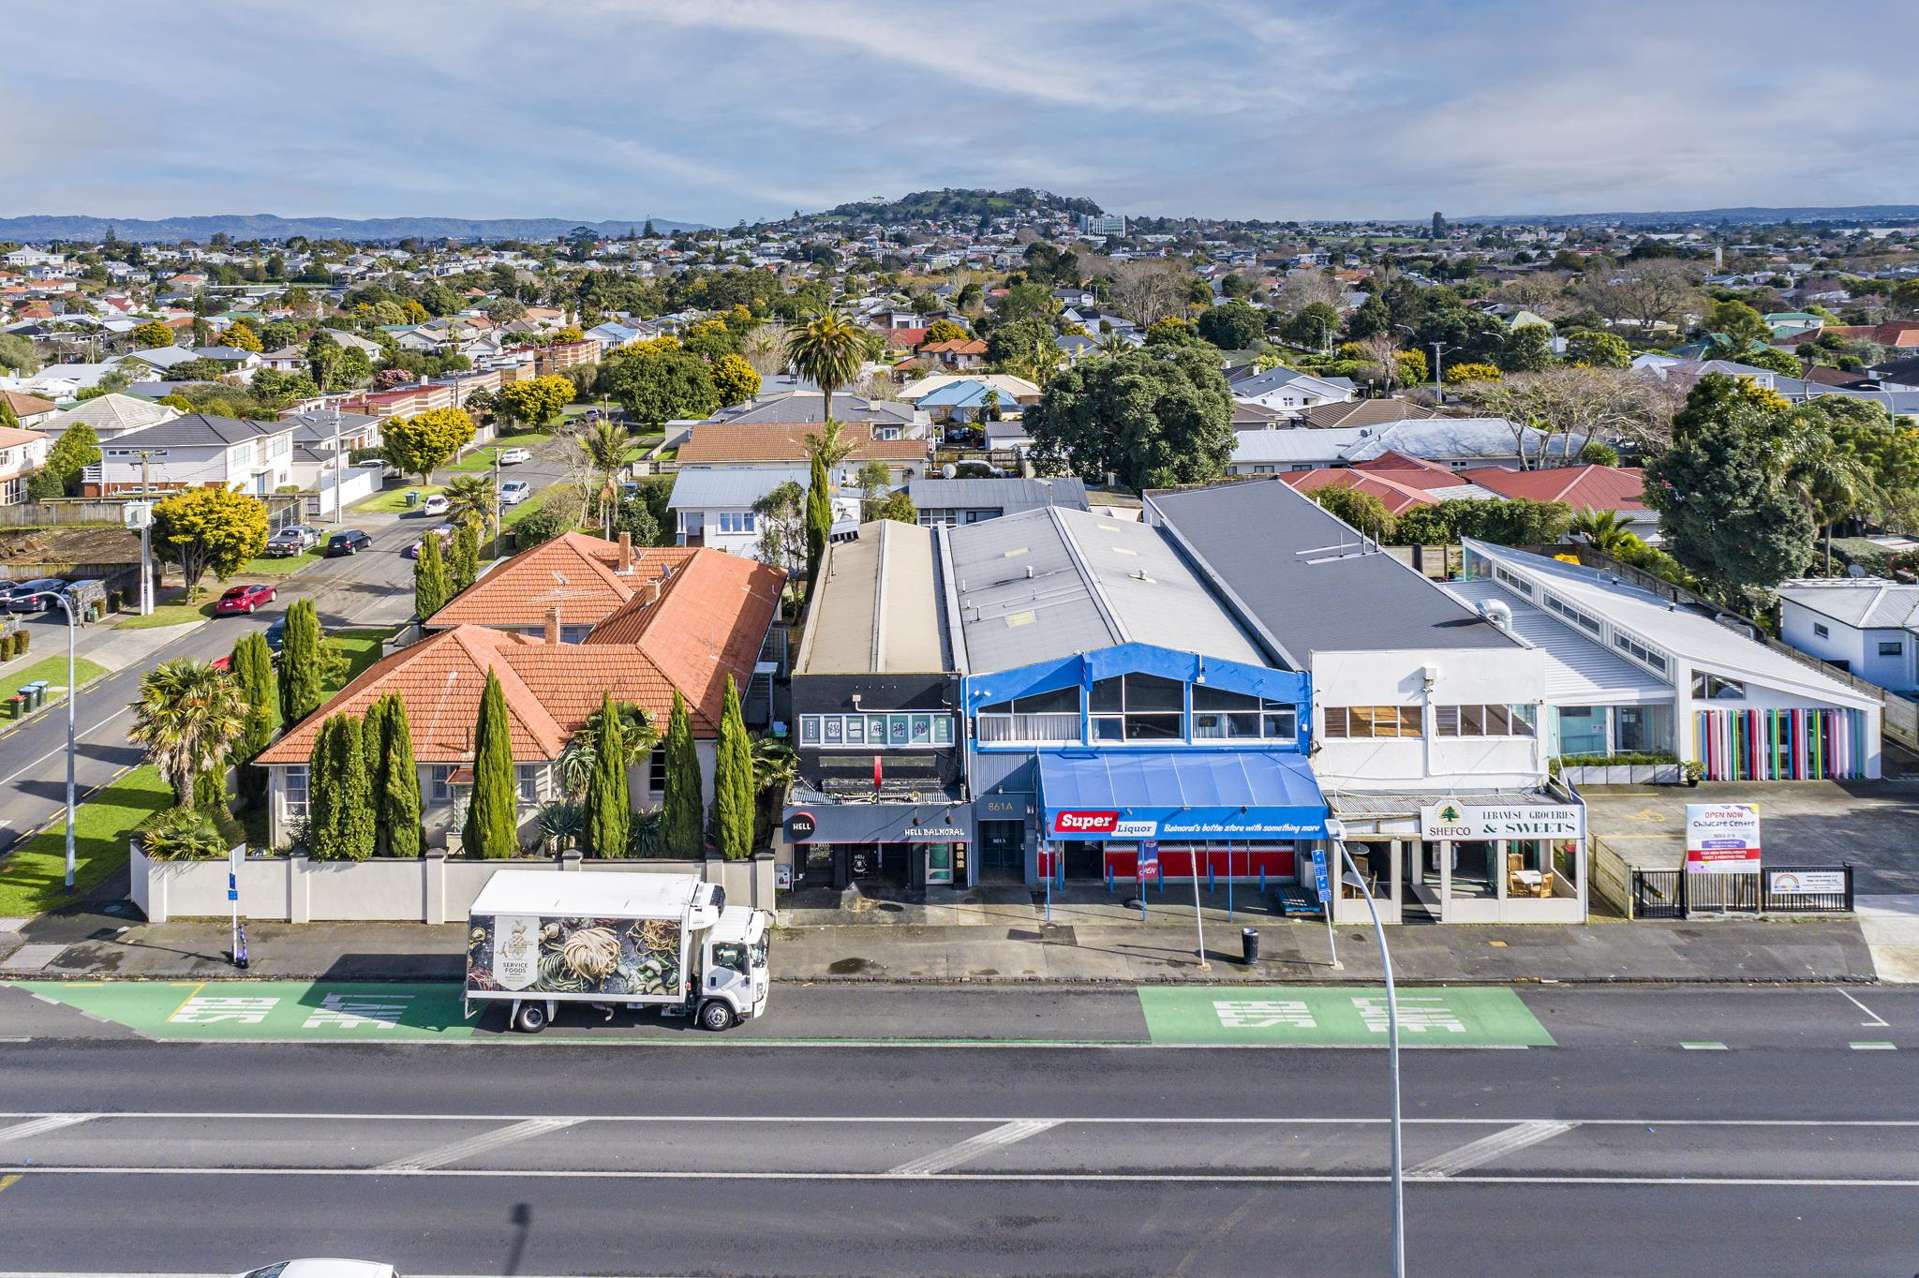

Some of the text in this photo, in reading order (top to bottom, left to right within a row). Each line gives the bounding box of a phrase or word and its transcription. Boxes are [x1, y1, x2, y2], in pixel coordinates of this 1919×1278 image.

[988, 802, 1013, 812] 861A
[1482, 810, 1576, 820] LEBANESE GROCERIES
[1705, 811, 1725, 819] OPEN
[1061, 814, 1113, 830] Super
[1117, 824, 1153, 834] Liquor
[1245, 823, 1263, 832] with
[1263, 823, 1301, 834] something
[1429, 827, 1471, 837] SHEFCO
[1482, 823, 1576, 834] & SWEETS
